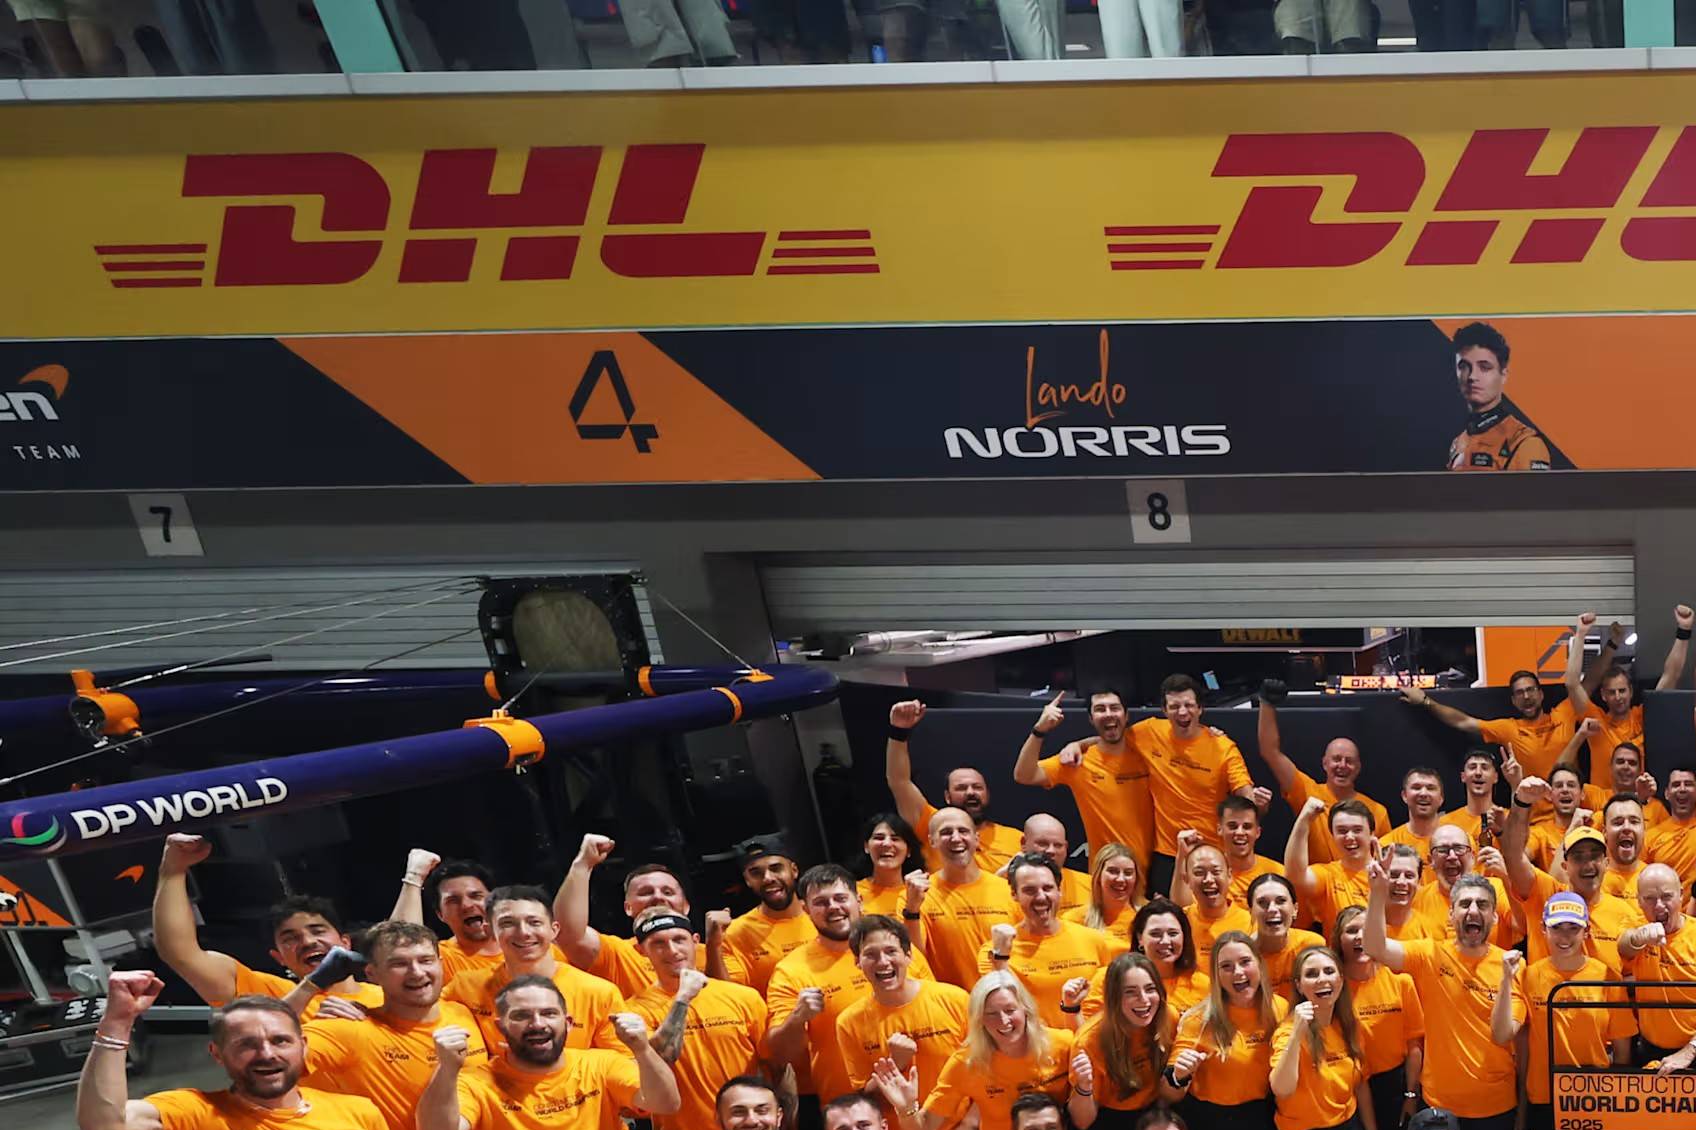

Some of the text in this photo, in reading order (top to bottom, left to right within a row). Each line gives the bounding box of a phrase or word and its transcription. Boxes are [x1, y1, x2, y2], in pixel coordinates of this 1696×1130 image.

[182, 143, 766, 287] DHL
[1025, 329, 1127, 429] Lando
[568, 350, 659, 453] 4
[13, 445, 81, 460] TEAM
[943, 424, 1231, 459] NORRIS
[149, 506, 173, 544] 7
[1147, 492, 1172, 531] 8
[70, 777, 288, 840] DP WORLD
[1559, 1095, 1640, 1113] WORLD
[1560, 1118, 1603, 1130] 2025
